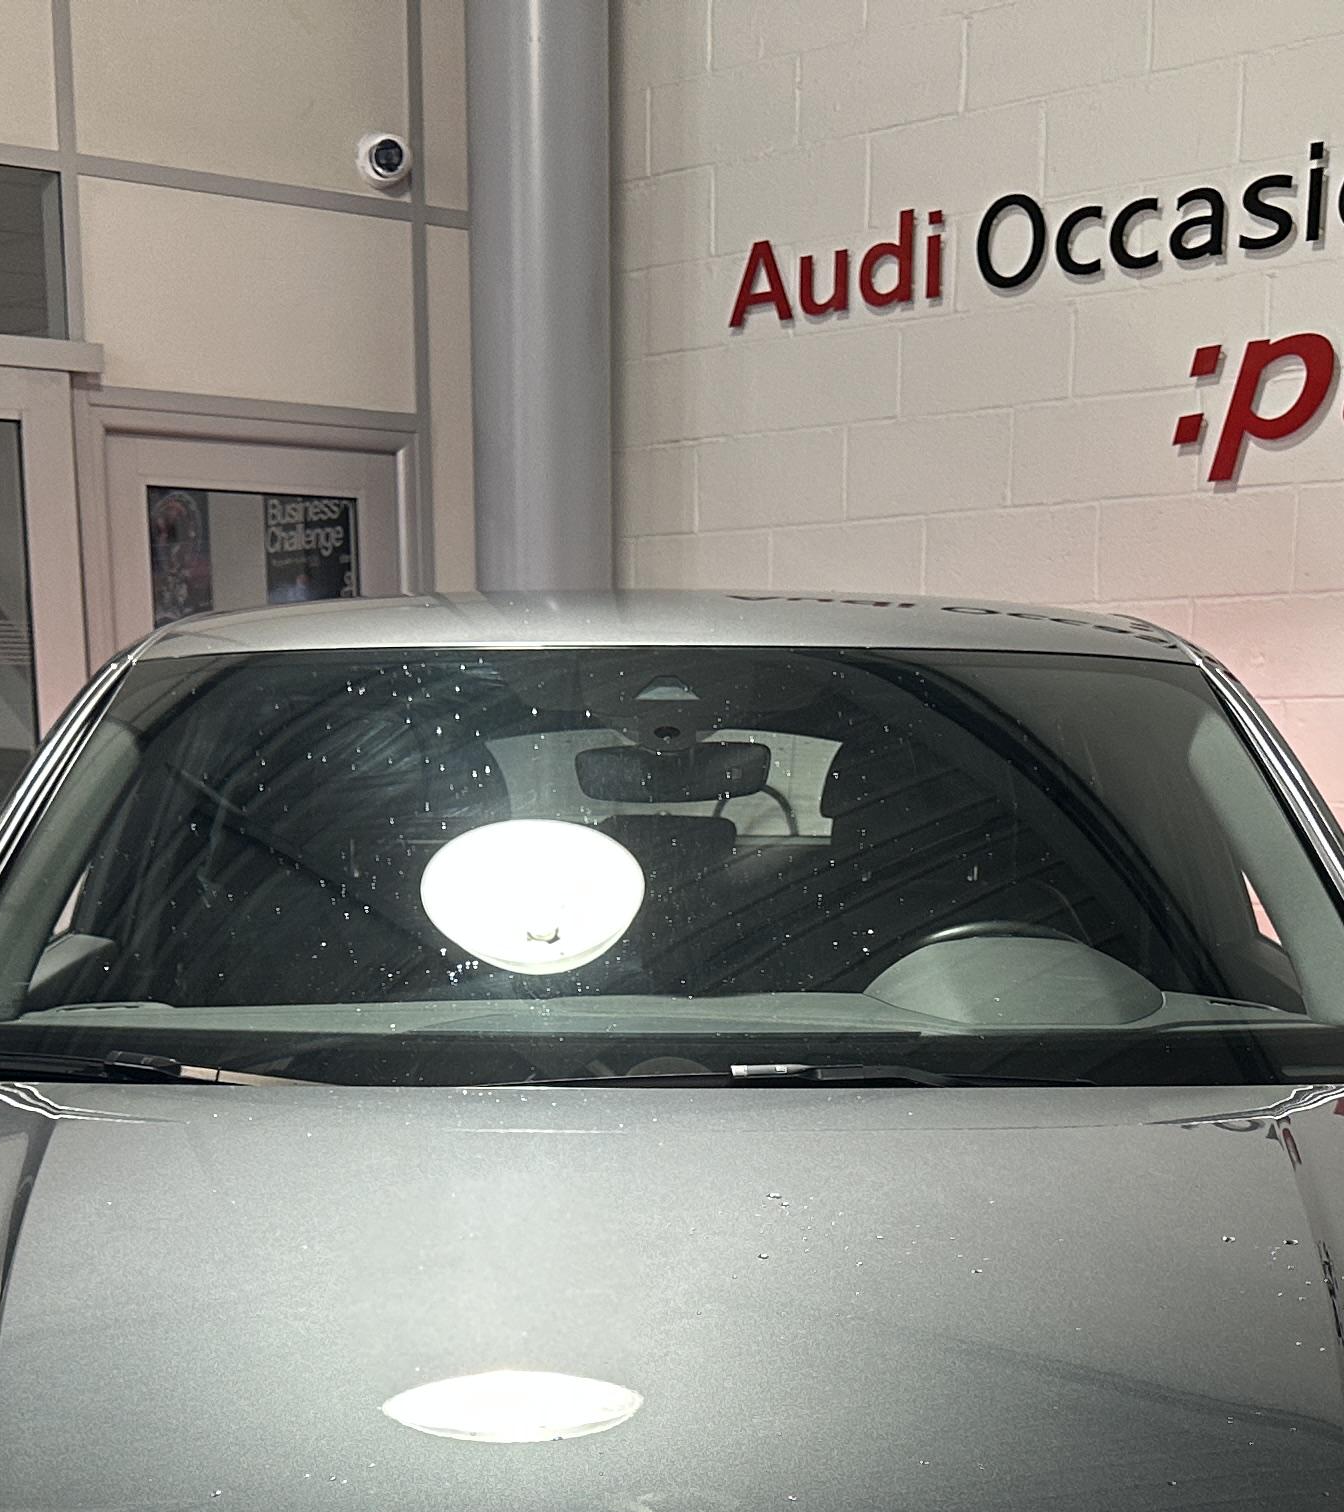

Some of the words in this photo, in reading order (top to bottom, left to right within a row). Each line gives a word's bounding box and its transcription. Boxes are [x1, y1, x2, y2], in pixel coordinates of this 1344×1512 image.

[728, 207, 944, 329] Audi
[267, 497, 341, 526] Business
[265, 523, 345, 558] Challenge
